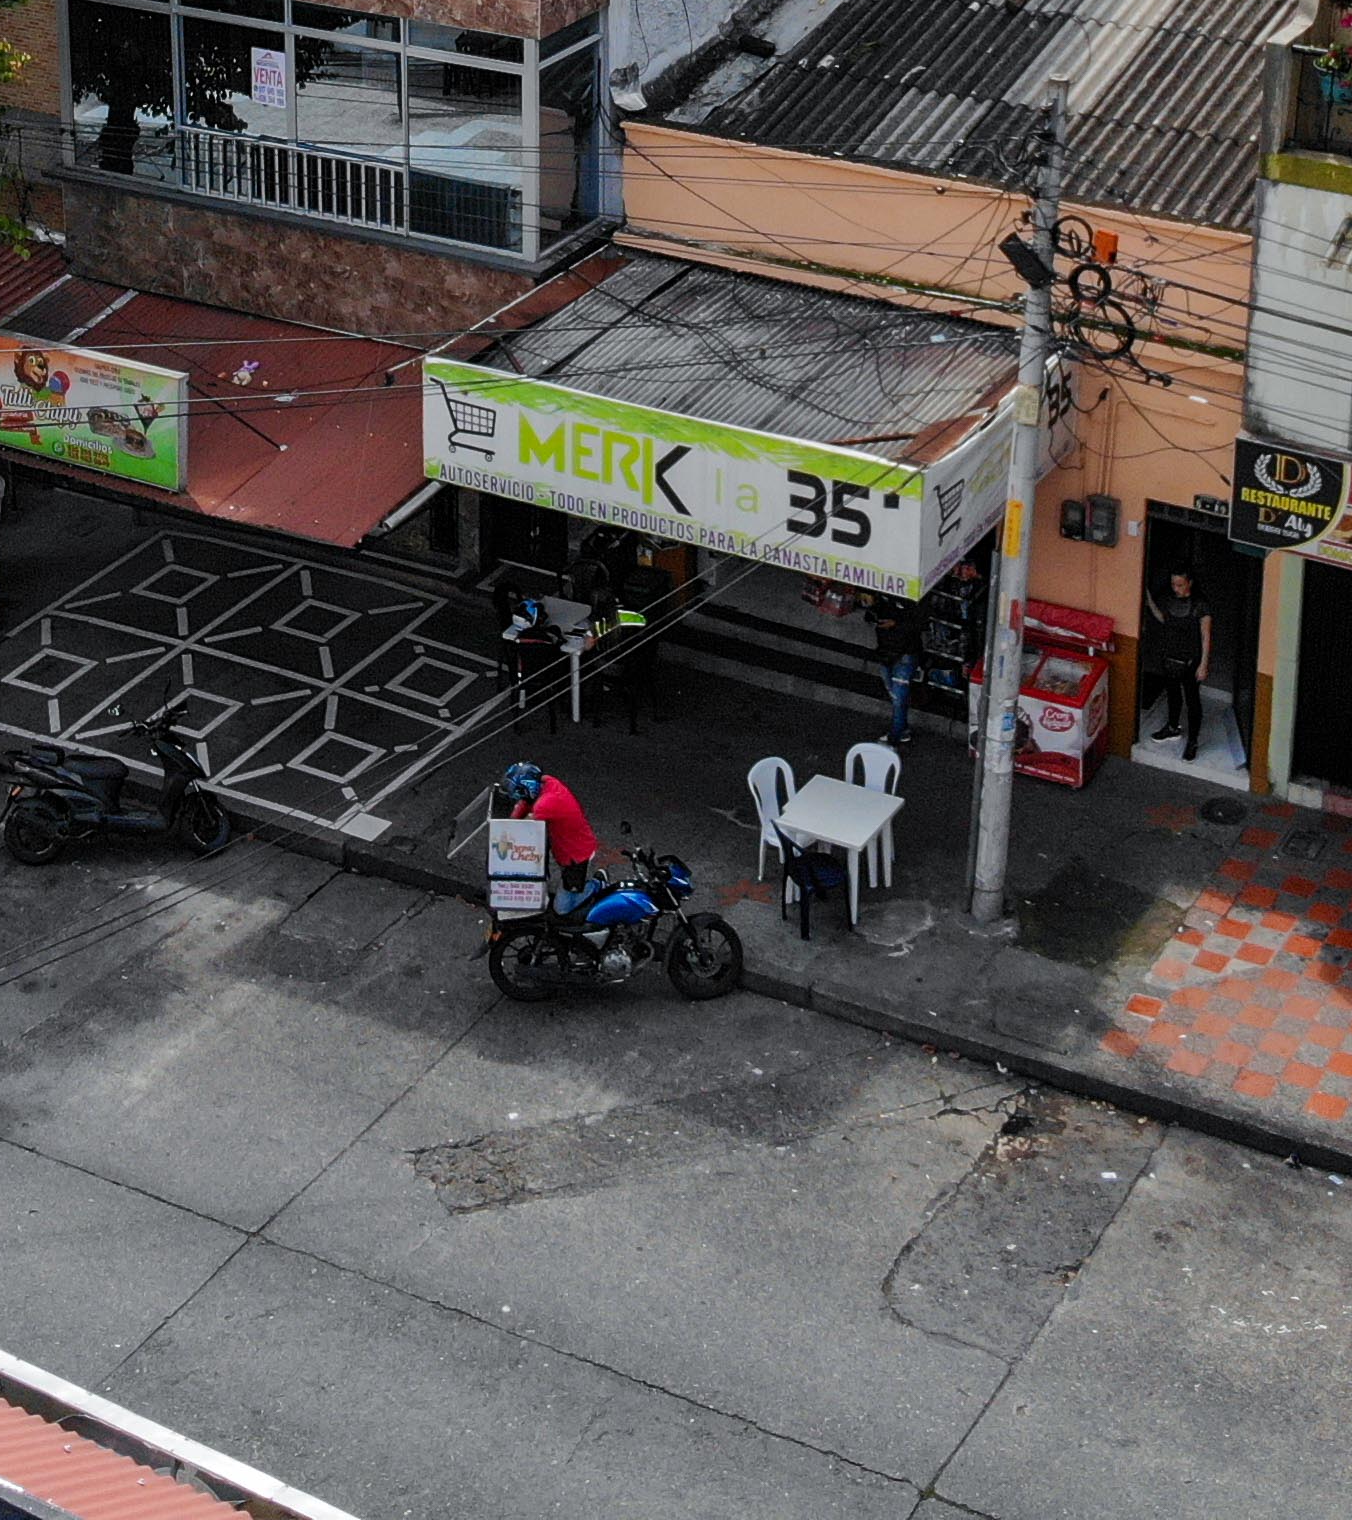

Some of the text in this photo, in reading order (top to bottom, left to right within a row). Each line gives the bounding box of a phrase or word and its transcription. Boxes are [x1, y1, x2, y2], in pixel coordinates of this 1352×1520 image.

[254, 67, 283, 88] VENTA
[518, 409, 692, 517] MERK
[714, 468, 761, 513] la
[439, 463, 534, 501] AUTOSERVICIO
[550, 490, 585, 514] TODO
[589, 502, 607, 520] EN
[612, 506, 695, 541] PRODUCTOS
[699, 527, 736, 552] PARA
[740, 537, 758, 558] LA
[763, 543, 829, 576] CANASTA
[835, 562, 906, 596] FAMILIAR
[1241, 487, 1333, 520] RESTAURANTE
